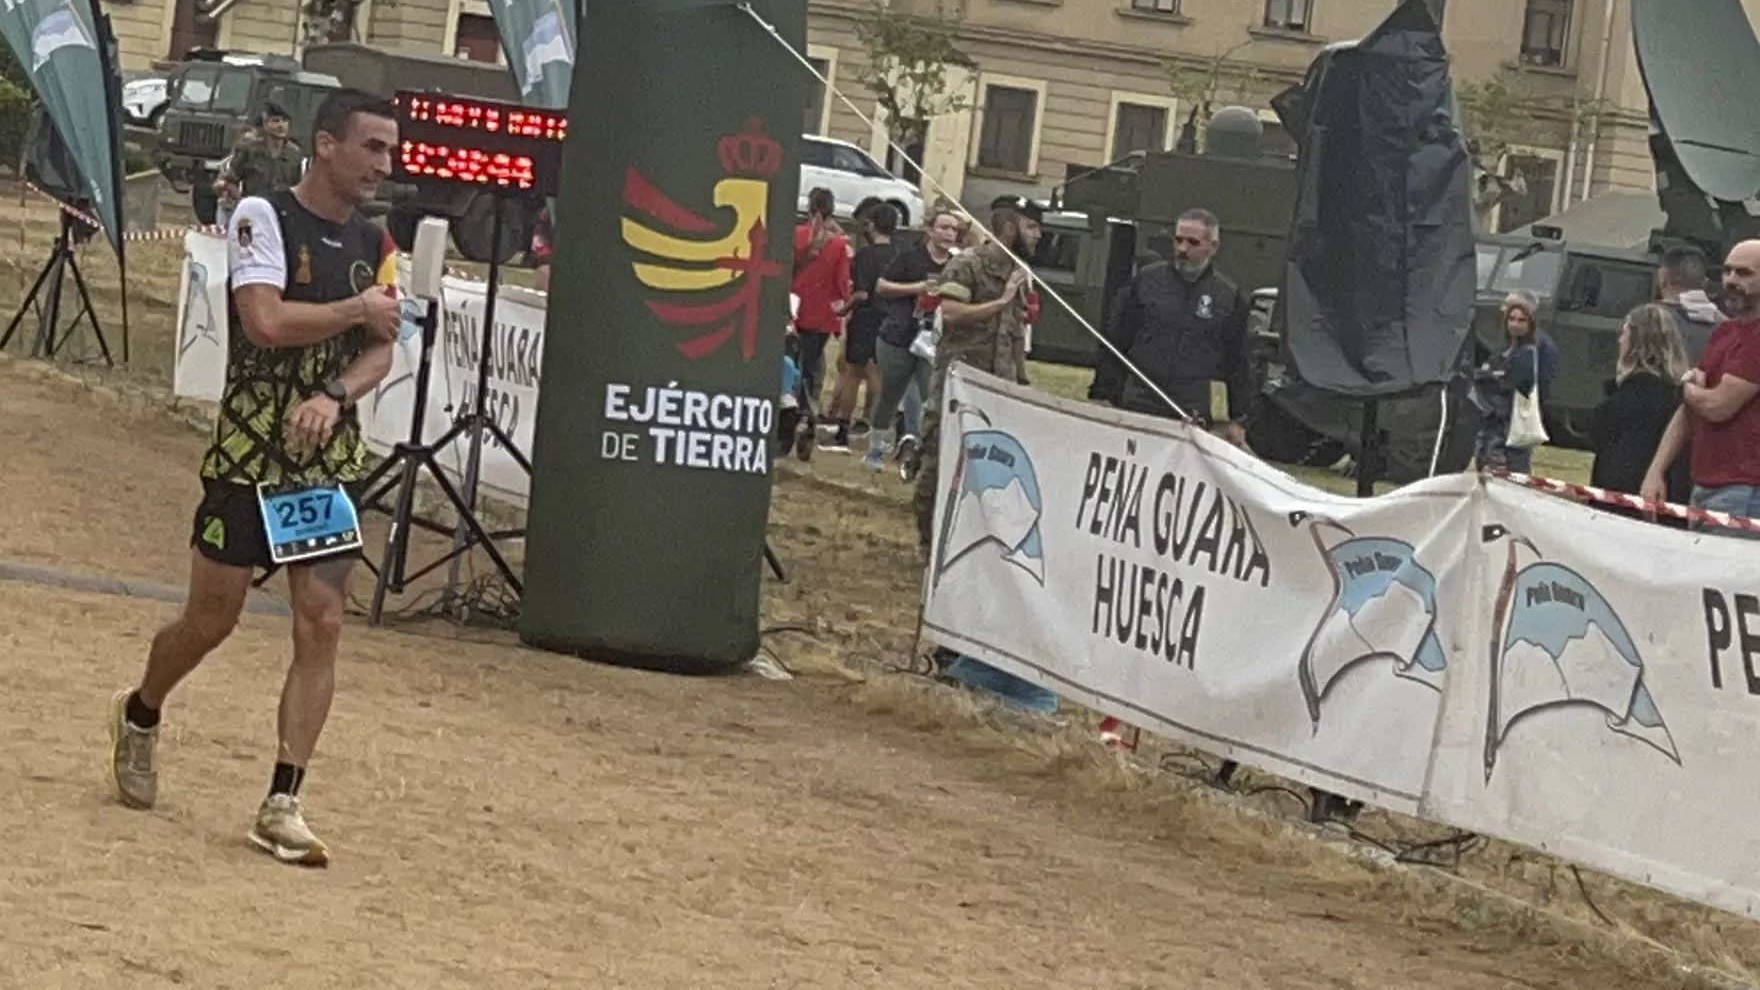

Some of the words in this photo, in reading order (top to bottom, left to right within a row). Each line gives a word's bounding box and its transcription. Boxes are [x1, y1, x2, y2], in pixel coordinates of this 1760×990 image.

[604, 380, 773, 435] EJÉRCITO
[601, 431, 640, 461] DE
[648, 427, 768, 475] TIERRA
[280, 493, 334, 529] 257
[1076, 438, 1149, 548] PEÑA
[1154, 472, 1271, 588] GUARA
[1092, 553, 1205, 672] HUESCA
